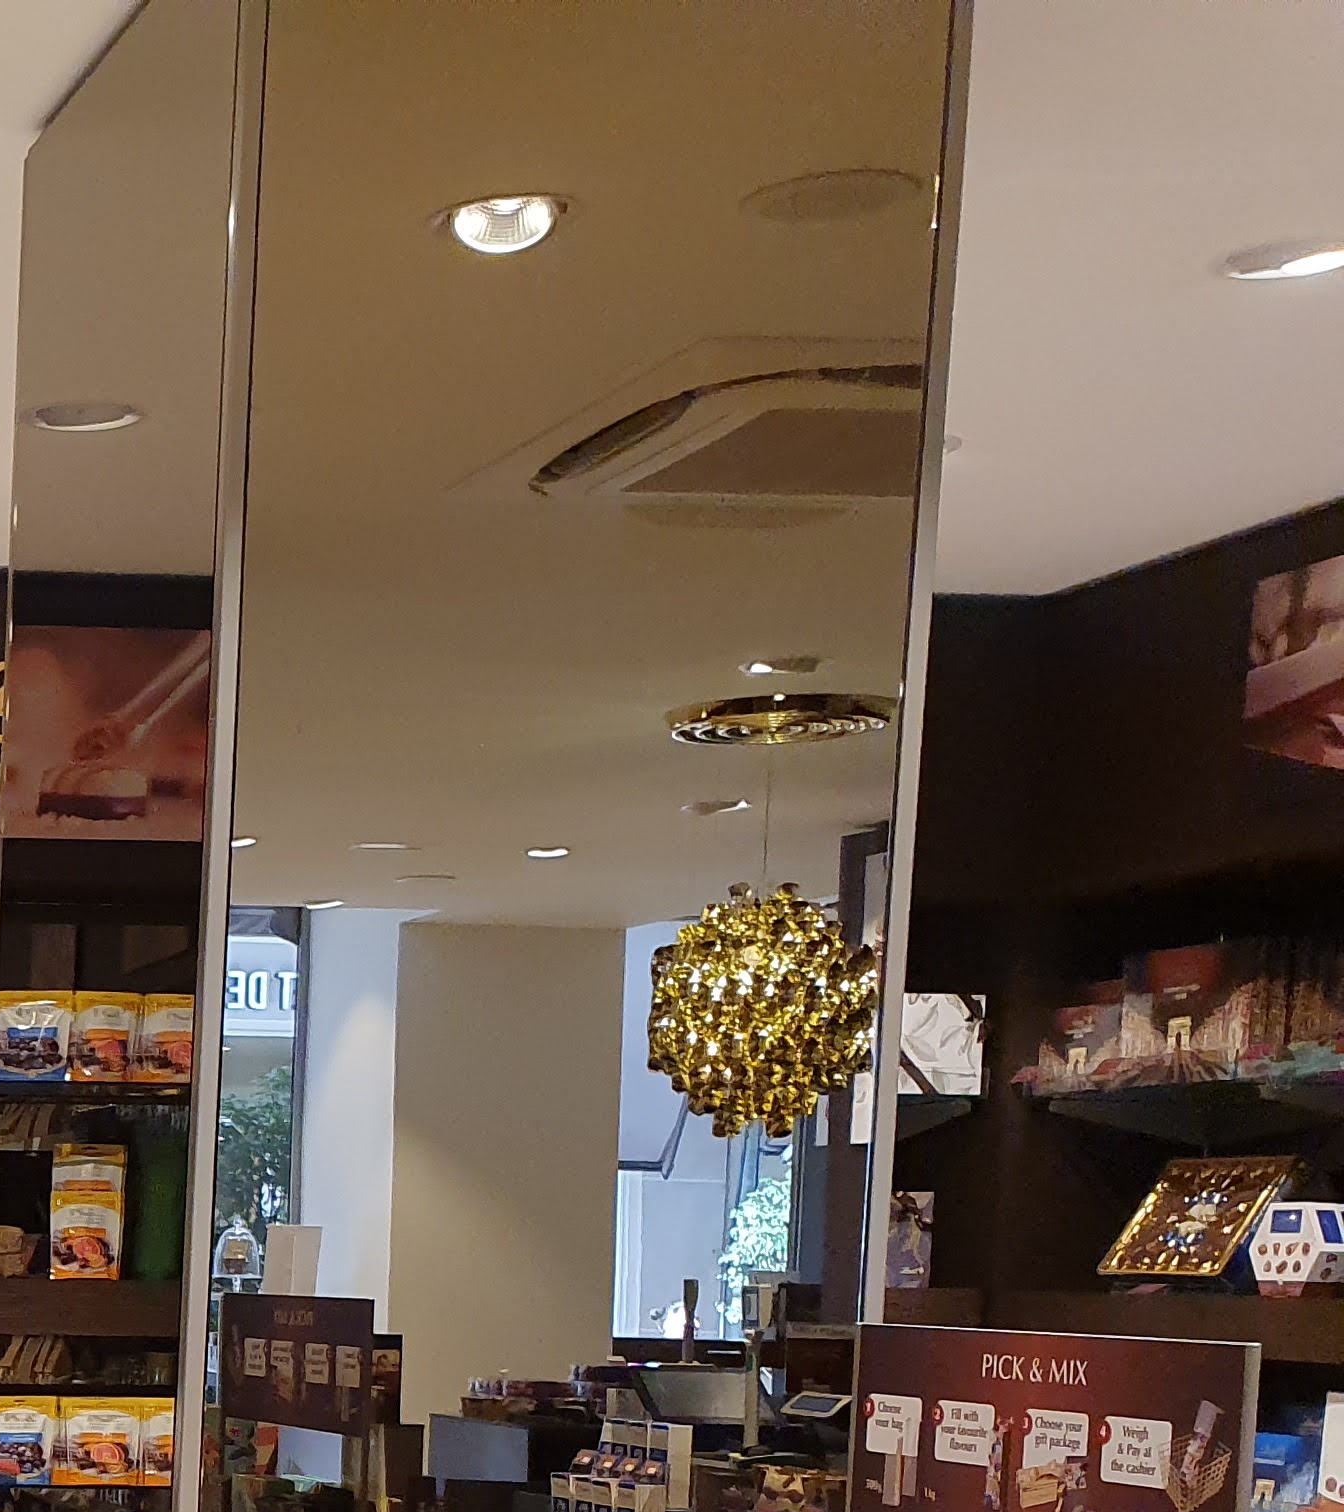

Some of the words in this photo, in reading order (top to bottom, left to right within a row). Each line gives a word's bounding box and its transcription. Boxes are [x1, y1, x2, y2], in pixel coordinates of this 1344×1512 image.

[982, 1353, 1023, 1380] PICK
[1029, 1357, 1043, 1383] &
[1049, 1359, 1089, 1387] MIX
[1122, 1425, 1149, 1442] Weigh
